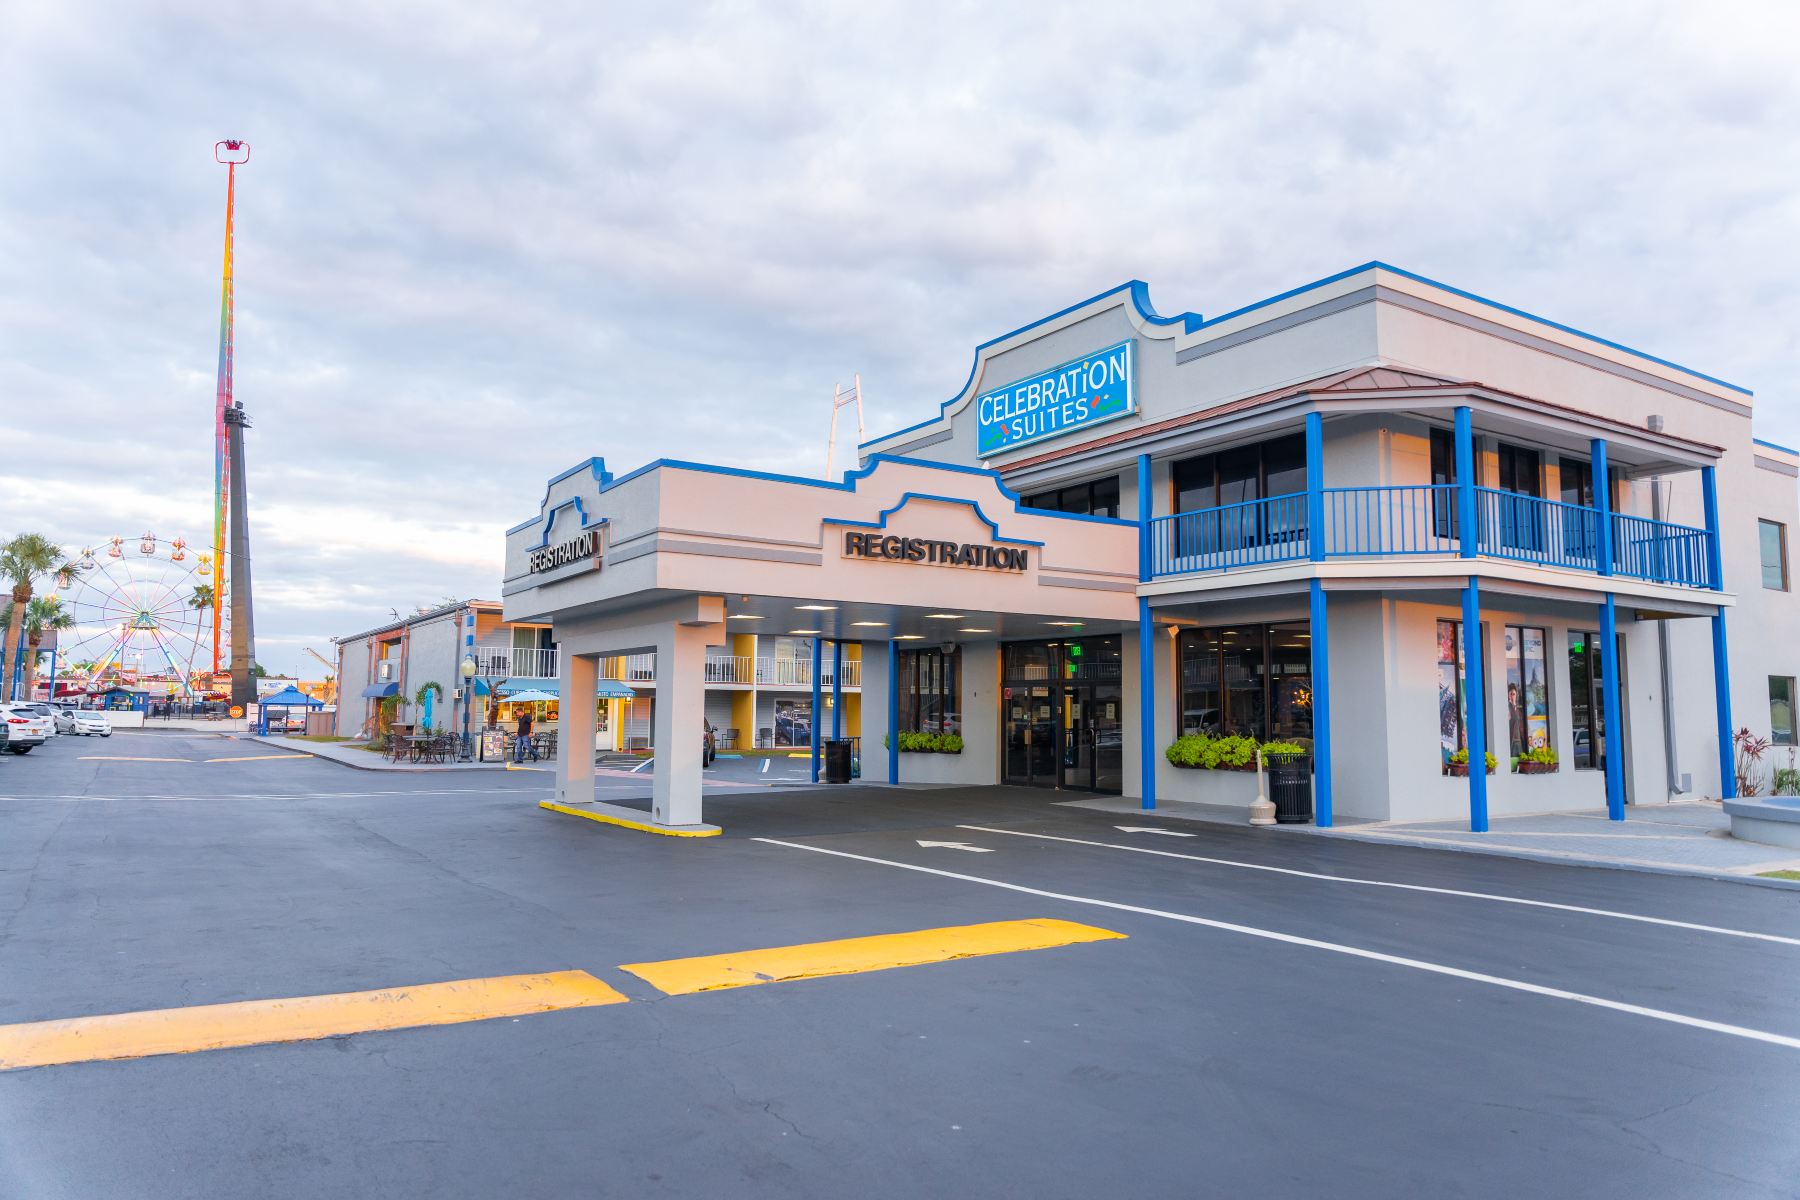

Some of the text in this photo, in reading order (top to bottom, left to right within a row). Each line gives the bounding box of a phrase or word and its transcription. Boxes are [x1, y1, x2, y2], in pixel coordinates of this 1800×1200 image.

[1011, 398, 1089, 440] SUITES
[529, 531, 593, 573] REGISTRATION
[846, 531, 1028, 570] REGISTRATION
